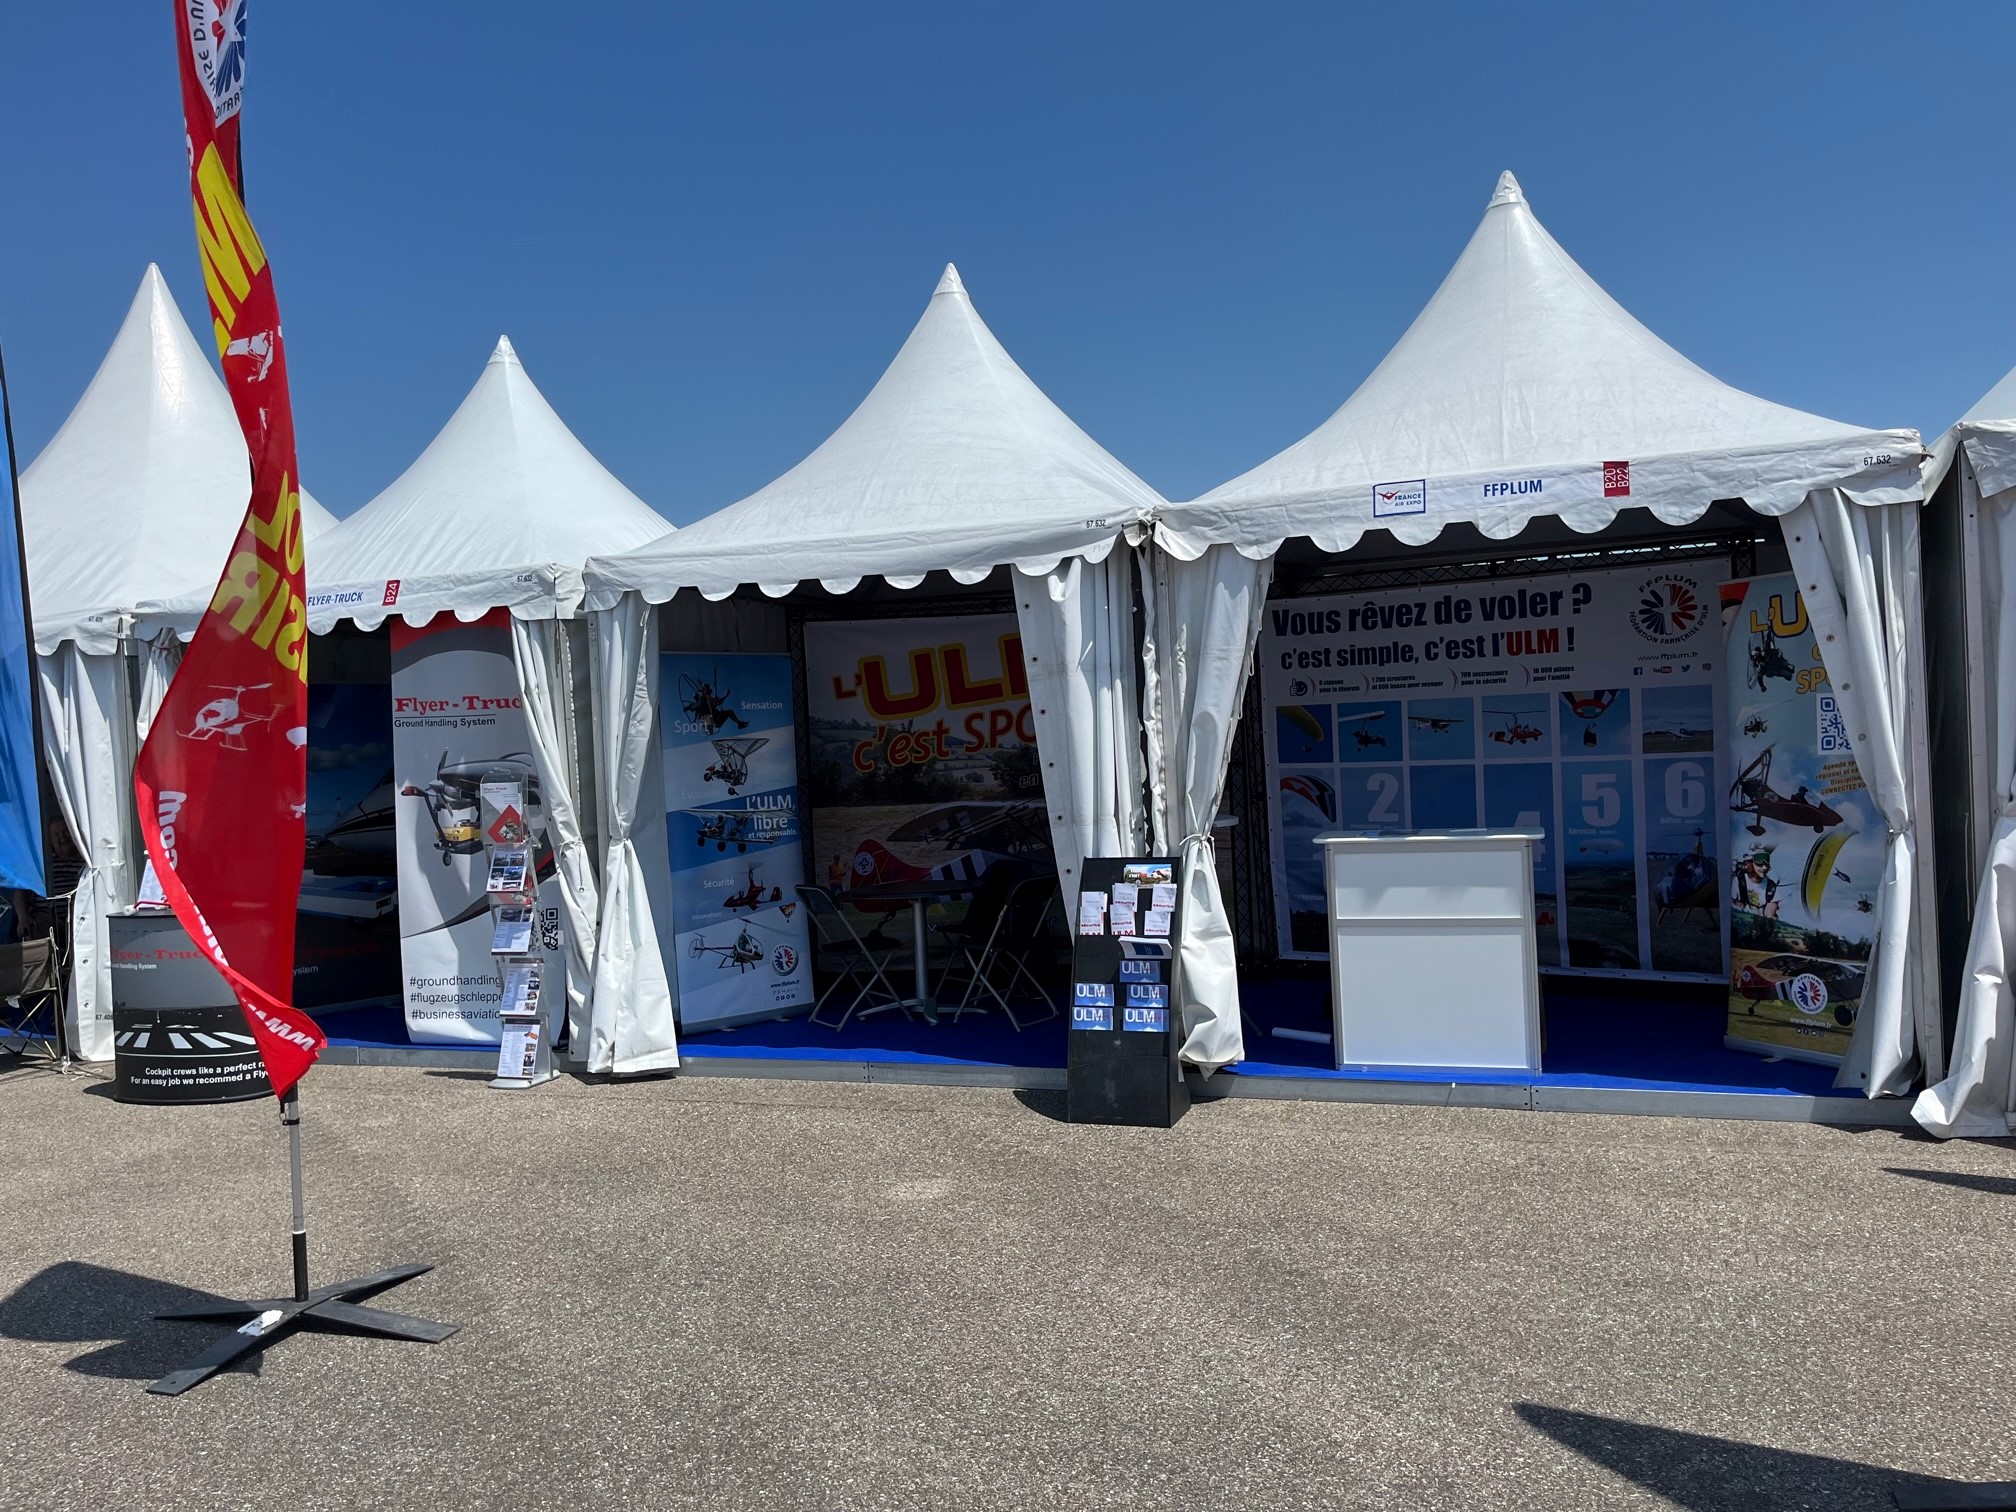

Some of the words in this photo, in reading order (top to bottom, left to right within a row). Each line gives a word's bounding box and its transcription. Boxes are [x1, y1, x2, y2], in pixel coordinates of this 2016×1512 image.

[1863, 454, 1891, 466] 67.632
[1605, 468, 1616, 488] B20
[1617, 467, 1628, 487] B22
[1483, 479, 1543, 497] FFPLUM
[1395, 493, 1422, 501] FRANCE
[1638, 574, 1698, 593] FFPLUM
[307, 592, 364, 606] FLYER-TRUCK
[385, 583, 398, 602] B24
[1272, 608, 1341, 637] Vous
[1348, 601, 1427, 631] rêvez
[1434, 595, 1472, 625] de
[1479, 586, 1563, 622] voler
[1571, 582, 1592, 614] ?
[1280, 647, 1332, 671] c'est
[1336, 641, 1419, 667] simple,
[1425, 635, 1486, 661] c'est
[1491, 627, 1560, 658] l'ULM
[1637, 651, 1699, 662] www.ffplum.fr
[740, 700, 783, 710] Sensation
[394, 719, 423, 728] Ground
[425, 718, 458, 728] Handling
[460, 717, 496, 728] System
[673, 720, 710, 736] Sport
[853, 717, 951, 774] c'est
[1664, 761, 1706, 818] 6
[745, 794, 796, 812] L'ULM,
[1366, 772, 1400, 823] 2
[1581, 773, 1621, 828] 5
[753, 814, 789, 830] libre
[703, 877, 735, 888] Sécurité
[691, 911, 723, 920] Innovation
[292, 965, 319, 976] ystem
[1121, 960, 1151, 974] ULM
[409, 974, 501, 989] #groundhandling
[1076, 984, 1106, 998] ULM
[1130, 985, 1160, 999] ULM
[1073, 1007, 1104, 1022] ULM
[1125, 1008, 1155, 1023] ULM
[145, 1067, 172, 1076] Cockpit
[199, 1066, 214, 1074] like
[223, 1061, 257, 1075] perfect
[131, 1076, 141, 1084] For
[151, 1079, 167, 1087] easy
[168, 1077, 181, 1087] job
[195, 1074, 243, 1084] recommed
